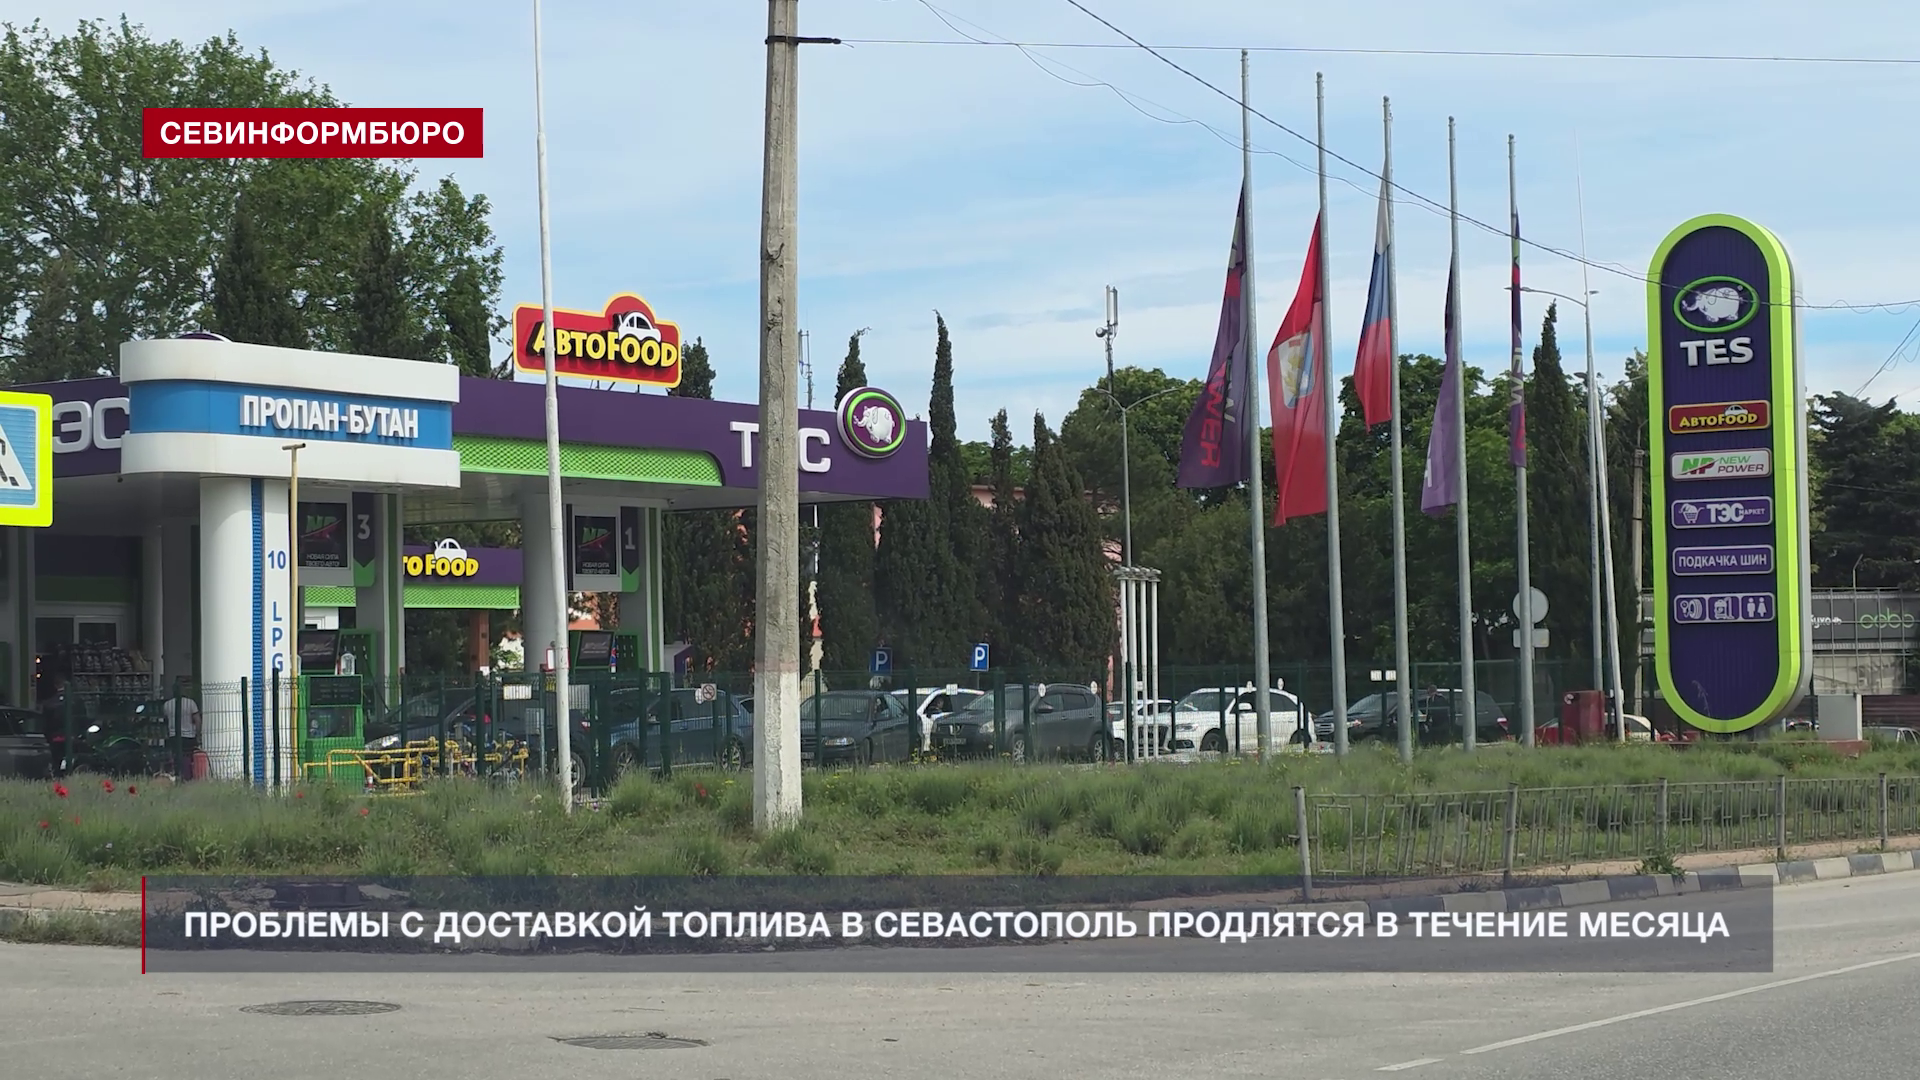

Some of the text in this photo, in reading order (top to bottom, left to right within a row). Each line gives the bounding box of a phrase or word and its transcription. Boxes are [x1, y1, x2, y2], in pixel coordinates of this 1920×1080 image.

[1680, 337, 1753, 366] TES
[52, 397, 130, 454] ЭС
[240, 395, 418, 438] ПРОПАН-БУТАН
[730, 421, 831, 473] ТС
[1718, 464, 1764, 474] POWER
[1719, 456, 1751, 465] NEW
[1706, 503, 1744, 523] ТЭС
[357, 514, 371, 540] 3
[625, 527, 636, 550] 1
[268, 550, 286, 570] 10
[1678, 554, 1767, 569] ПОДКАЧКА ШИН
[272, 601, 283, 672] LPG
[876, 651, 887, 671] P
[975, 647, 985, 668] P
